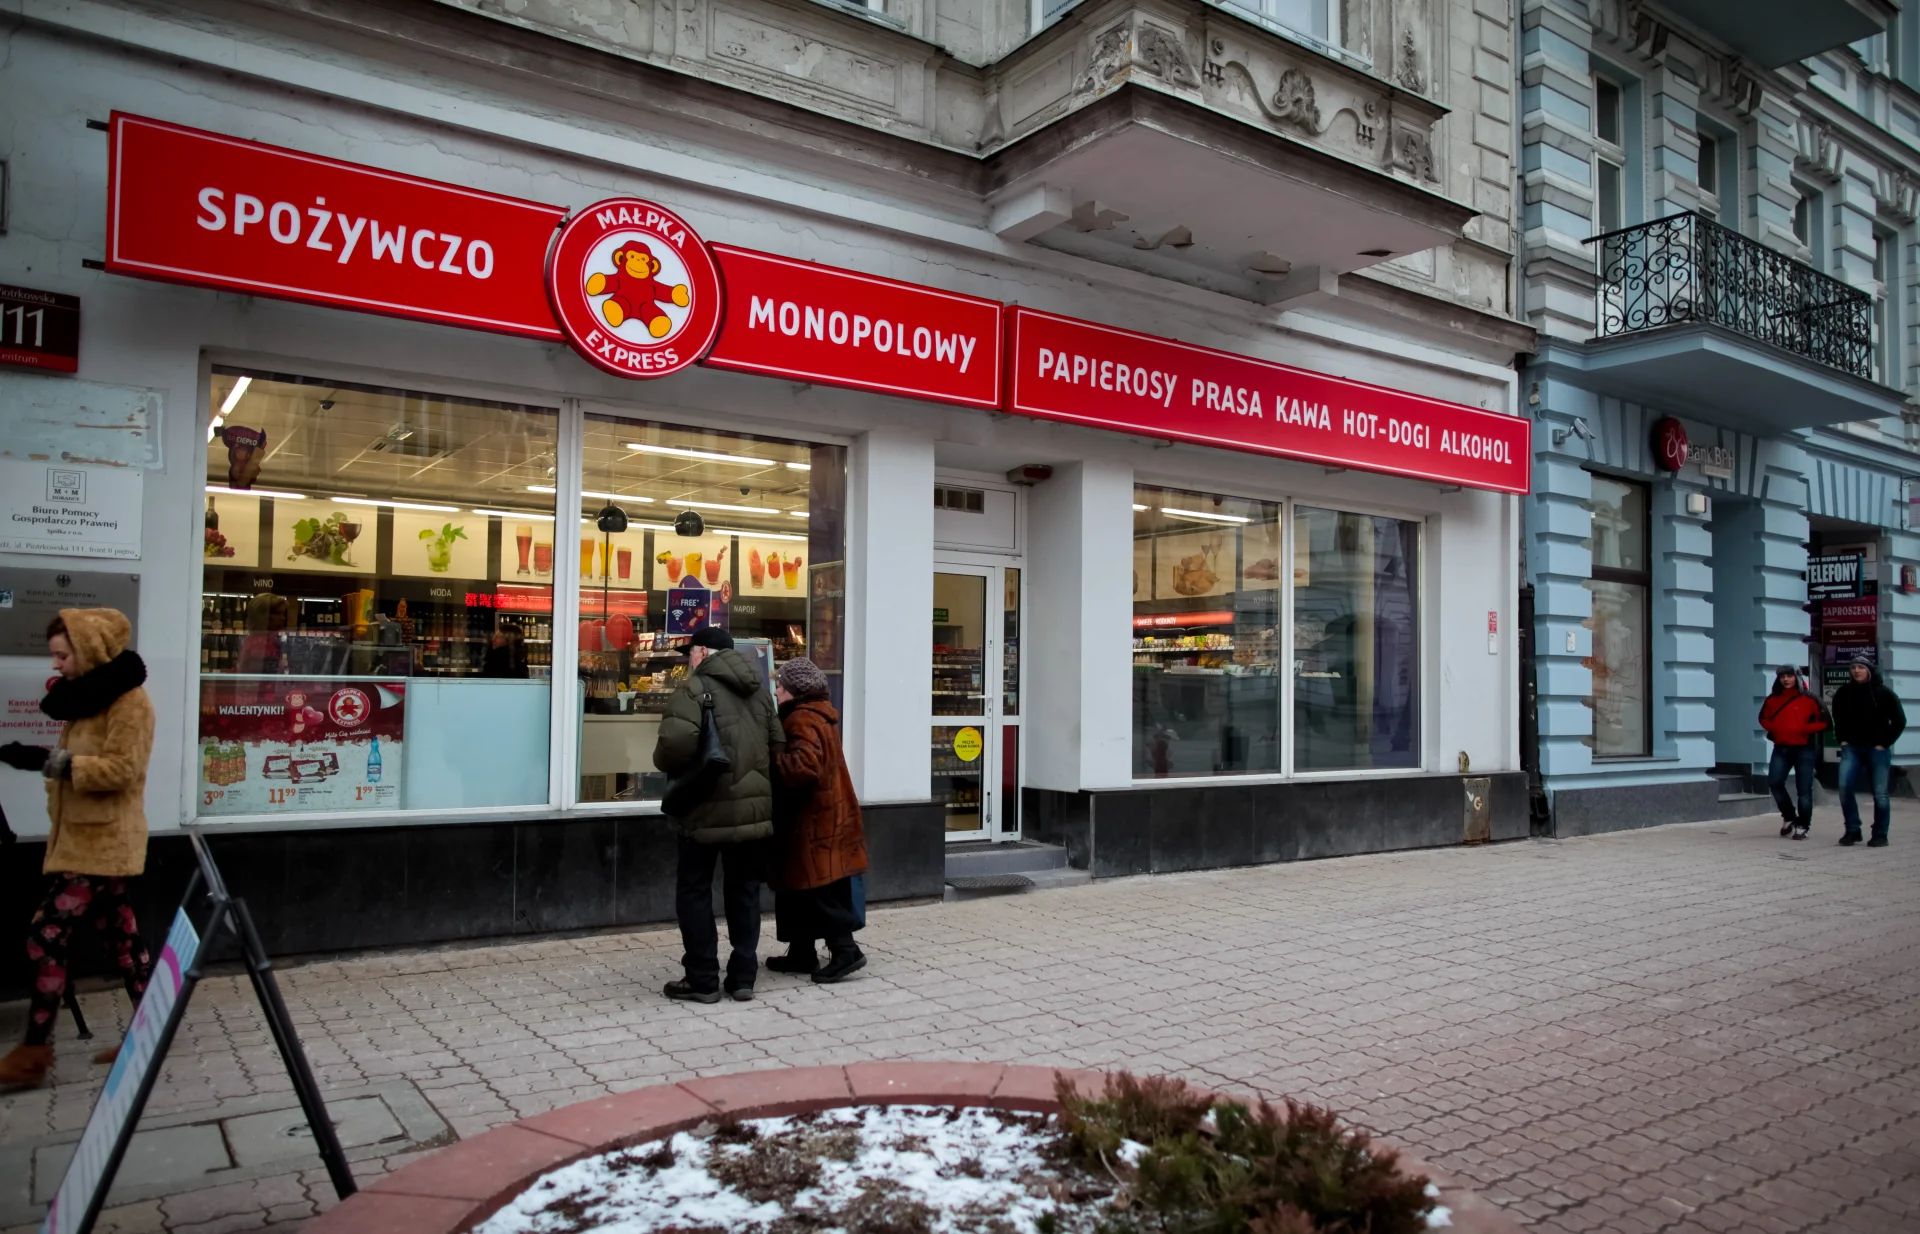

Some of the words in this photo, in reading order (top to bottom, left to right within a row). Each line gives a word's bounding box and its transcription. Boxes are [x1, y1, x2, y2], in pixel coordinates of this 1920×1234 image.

[196, 187, 495, 279] SPOŻYWCZO
[595, 206, 687, 249] MAŁPKA
[748, 295, 977, 374] MONOPOLOWY
[585, 329, 679, 370] EXPRESS
[0, 350, 38, 364] entrum
[1038, 347, 1178, 408] PAPIEROSY
[1191, 378, 1263, 419] PRASA
[1275, 395, 1332, 431] KAWA
[1343, 408, 1431, 450] HOT-DOGI
[1439, 429, 1512, 465] ALKOHOL
[236, 436, 258, 446] CIEPŁO
[1688, 441, 1713, 463] Bank
[1715, 446, 1734, 468] BPH
[32, 506, 58, 515] Biuro
[62, 508, 100, 519] Pomocy
[12, 514, 78, 526] Gospodarczo
[80, 518, 118, 530] Prawnej
[26, 542, 69, 552] Piotrkowska
[1806, 562, 1858, 583] TELEFONY
[253, 578, 274, 588] WINO
[430, 588, 452, 598] WODA
[733, 605, 756, 614] NAPOJE
[1822, 606, 1876, 617] ZAPROSZENIA
[218, 705, 285, 717] WALENTYNKI!
